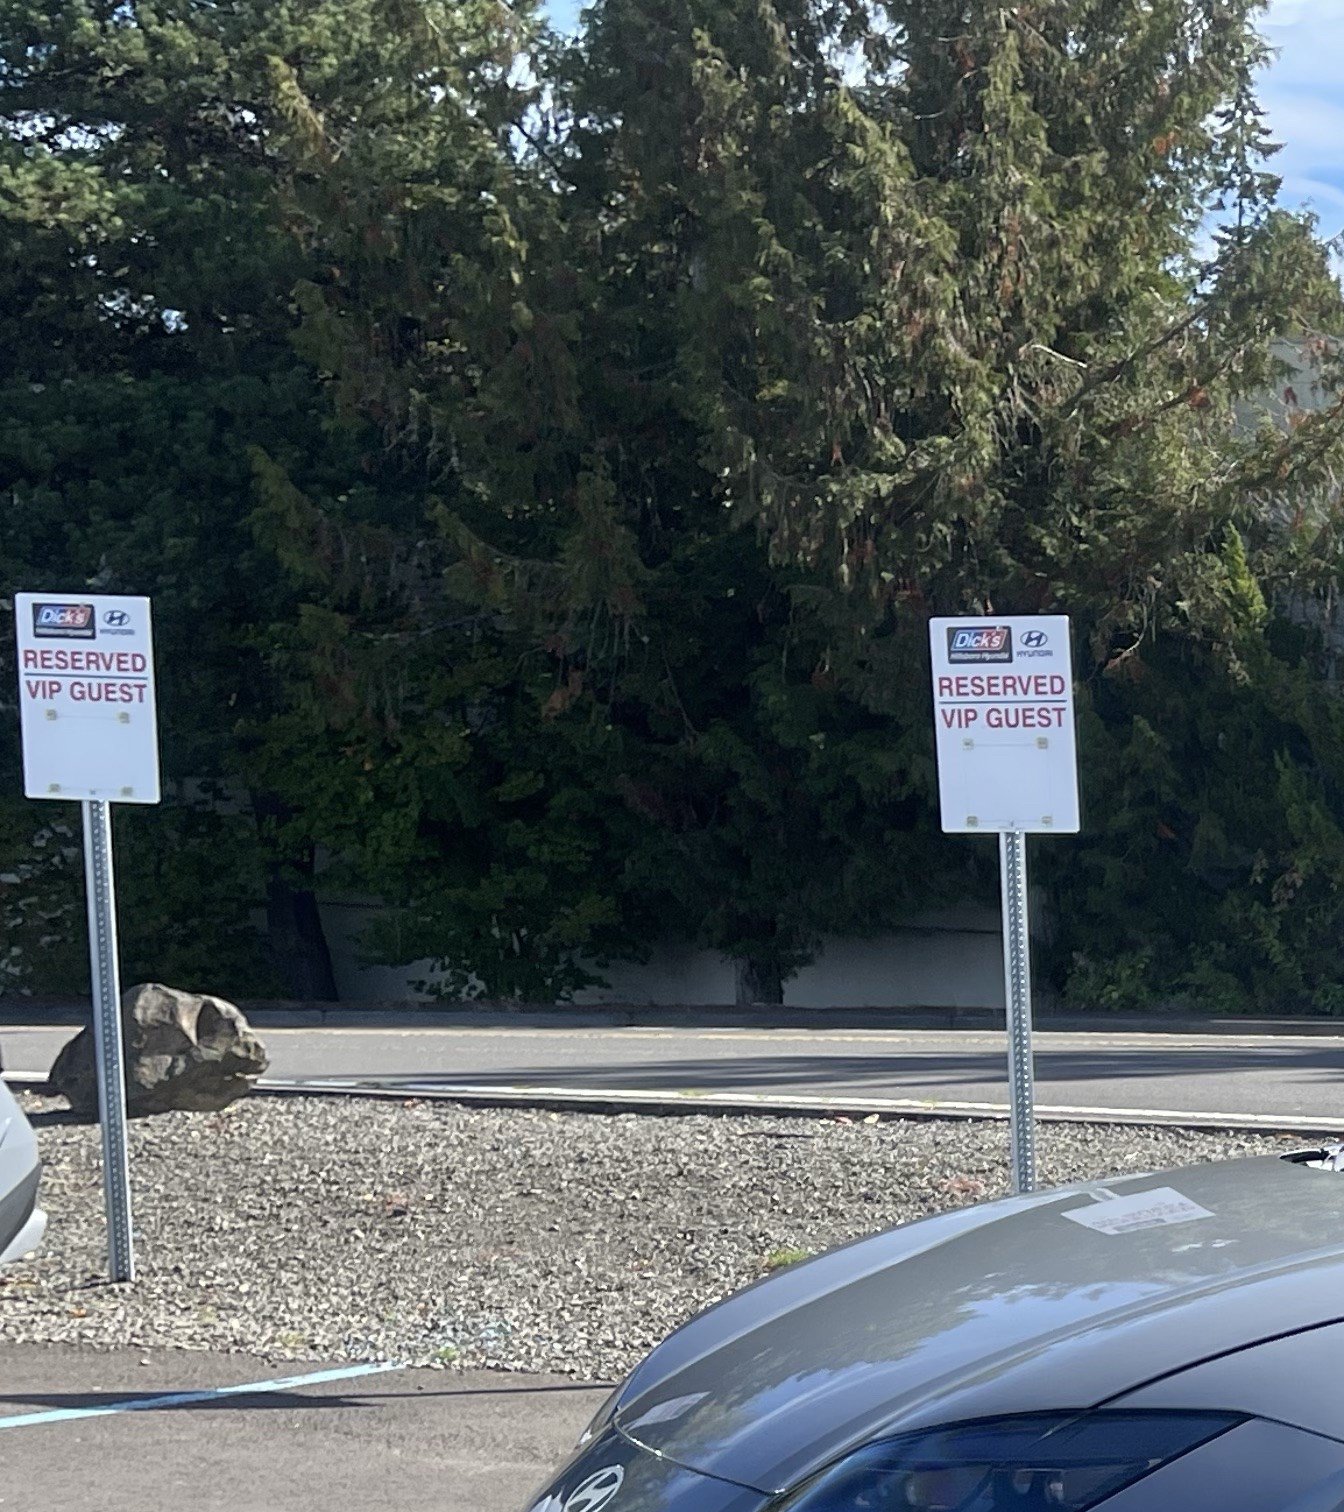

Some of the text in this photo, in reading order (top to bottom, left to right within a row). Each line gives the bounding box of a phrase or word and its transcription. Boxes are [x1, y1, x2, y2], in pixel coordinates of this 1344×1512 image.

[24, 650, 146, 673] RESERVED
[26, 680, 147, 703] VIP GUEST
[938, 675, 1065, 697] RESERVED
[941, 707, 1066, 729] VIP GUEST
